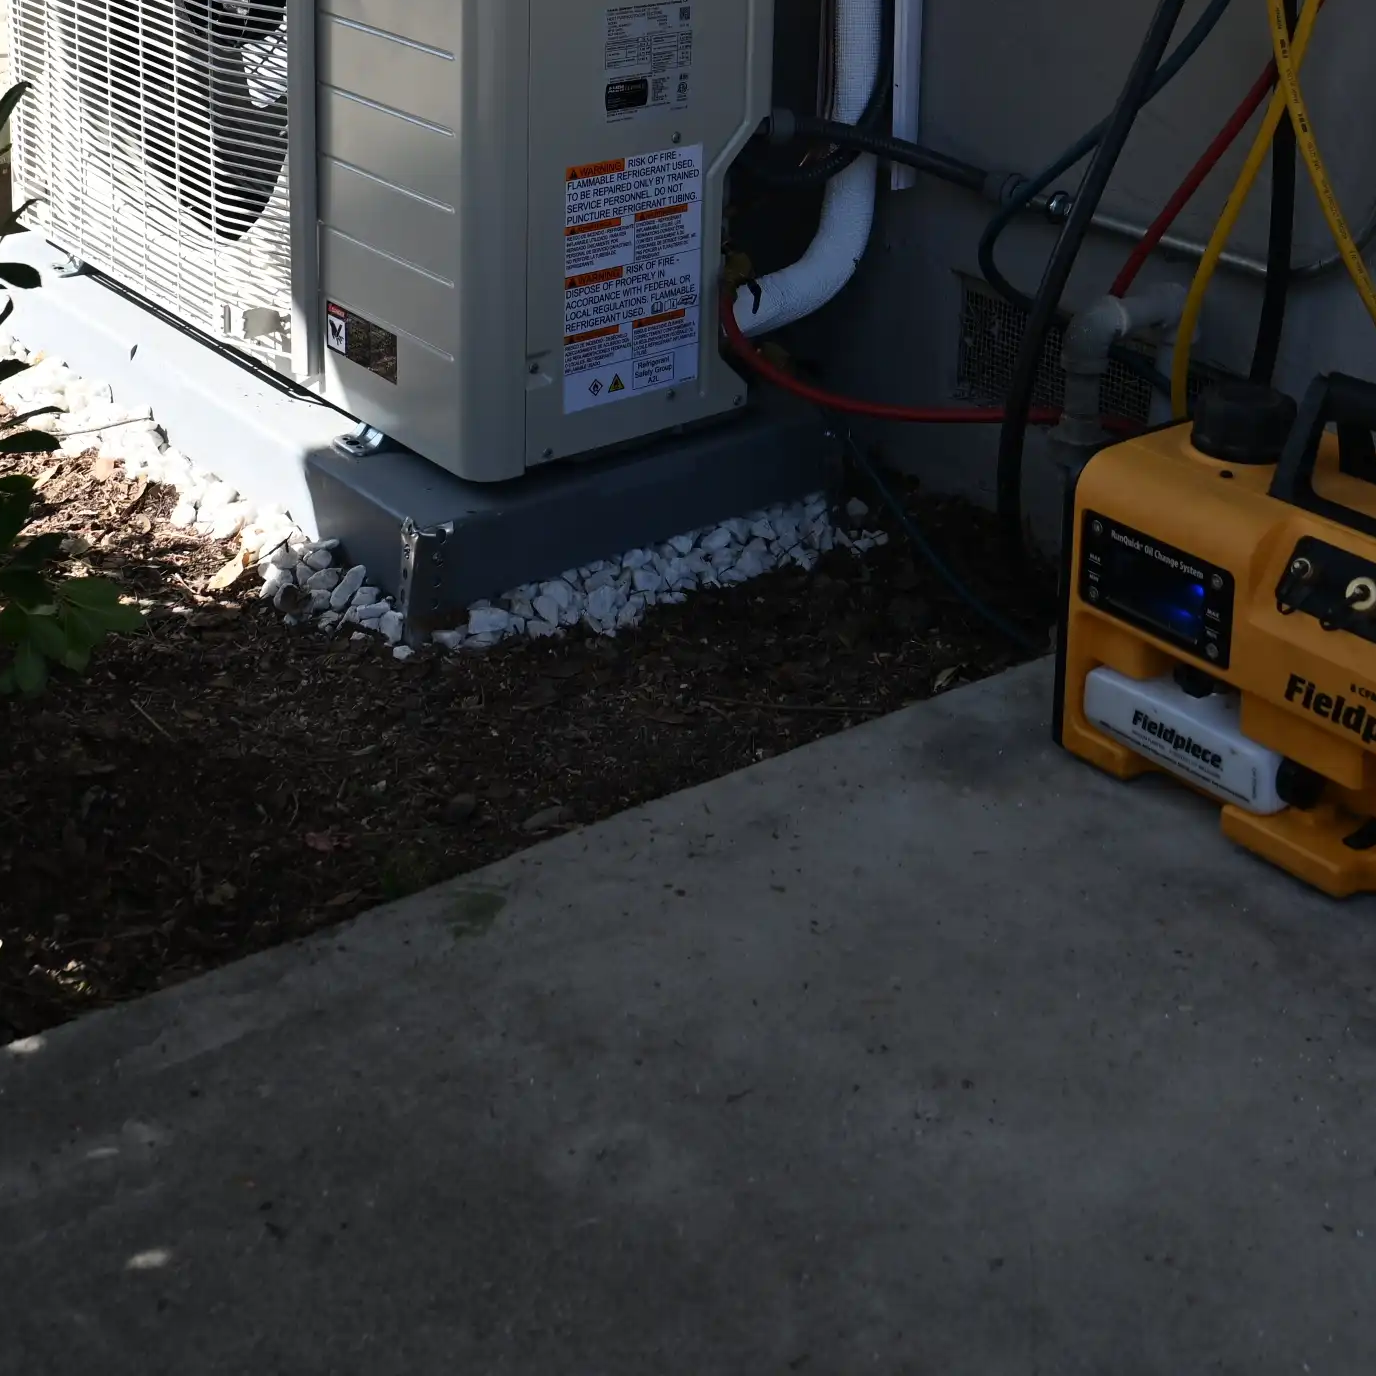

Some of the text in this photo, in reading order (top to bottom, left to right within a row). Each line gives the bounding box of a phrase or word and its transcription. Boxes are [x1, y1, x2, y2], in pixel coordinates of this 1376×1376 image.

[580, 162, 621, 177] WARNING
[628, 151, 677, 168] RISK OF FIRE
[567, 159, 695, 191] FLAMMABLE REFRIGERANT USED.
[567, 169, 699, 202] TO BE REPAIRED ONLY BY TRAINED
[567, 201, 603, 214] SERVICE
[654, 187, 665, 196] DO
[667, 183, 684, 194] NOT
[567, 211, 610, 226] PUNCTURE
[612, 197, 666, 216] REFRIGERANT
[668, 192, 698, 204] TUBING.
[578, 269, 622, 283] WARNING
[626, 258, 674, 275] RISK OF FIRE
[566, 269, 665, 299] DISPOSE OF PROPERLY IN
[566, 274, 691, 311] ACCORDANCE WITH FEDERAL OR
[565, 284, 695, 322] LOCAL REGULATIONS. FLAMMABLE
[565, 312, 620, 333] REFRIGERANT
[622, 307, 645, 319] USED.
[634, 364, 673, 379] Safety Group
[637, 355, 670, 369] Refrigerant
[648, 375, 659, 384] A2L
[1144, 544, 1154, 557] Oil
[1154, 550, 1179, 569] Change
[1180, 561, 1204, 579] System
[1132, 709, 1223, 769] Fieldpiece
